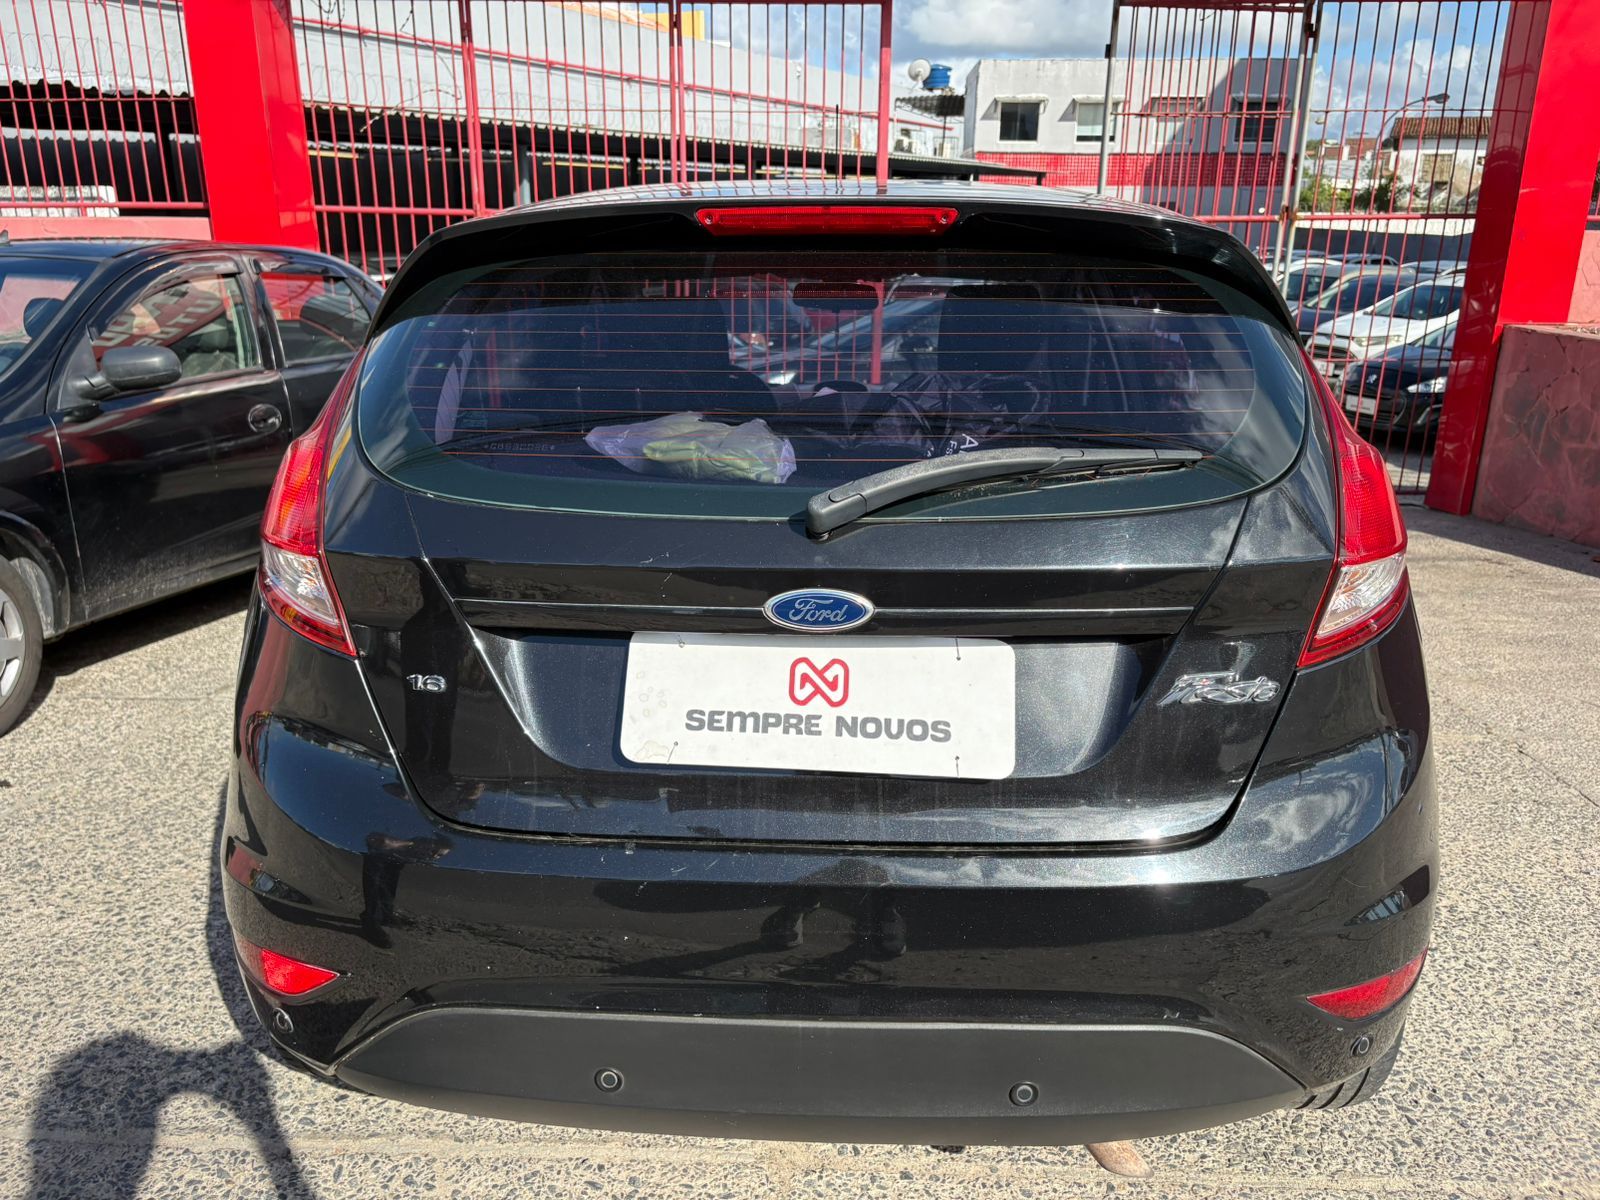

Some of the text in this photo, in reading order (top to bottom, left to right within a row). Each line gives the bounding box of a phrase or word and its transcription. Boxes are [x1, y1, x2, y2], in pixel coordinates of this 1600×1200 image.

[788, 598, 849, 621] Ford
[685, 708, 952, 743] SEMPRE NOVOS
